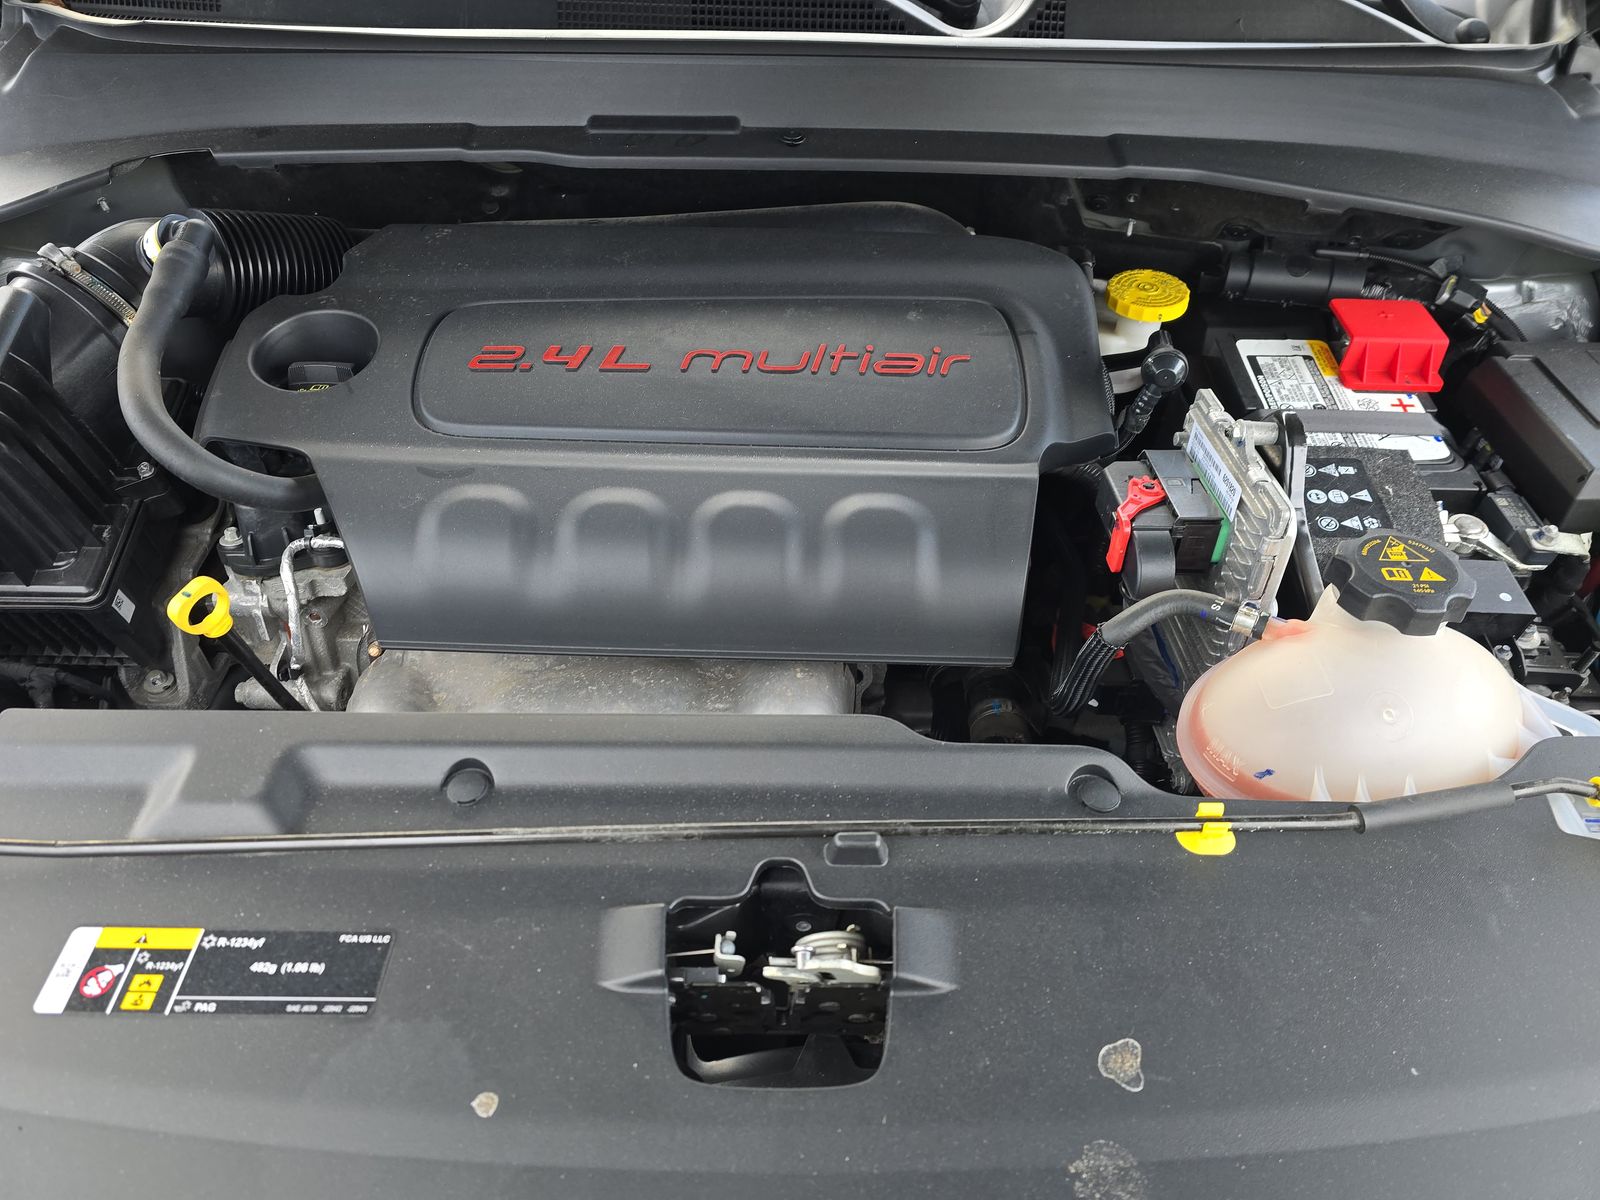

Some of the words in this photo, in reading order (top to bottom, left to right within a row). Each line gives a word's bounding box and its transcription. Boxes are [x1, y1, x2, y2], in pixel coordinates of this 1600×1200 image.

[466, 344, 652, 373] 2.4L
[680, 343, 972, 376] multiair
[216, 937, 266, 950] R-1234yf
[338, 934, 358, 943] FCA
[372, 934, 391, 943] LLC
